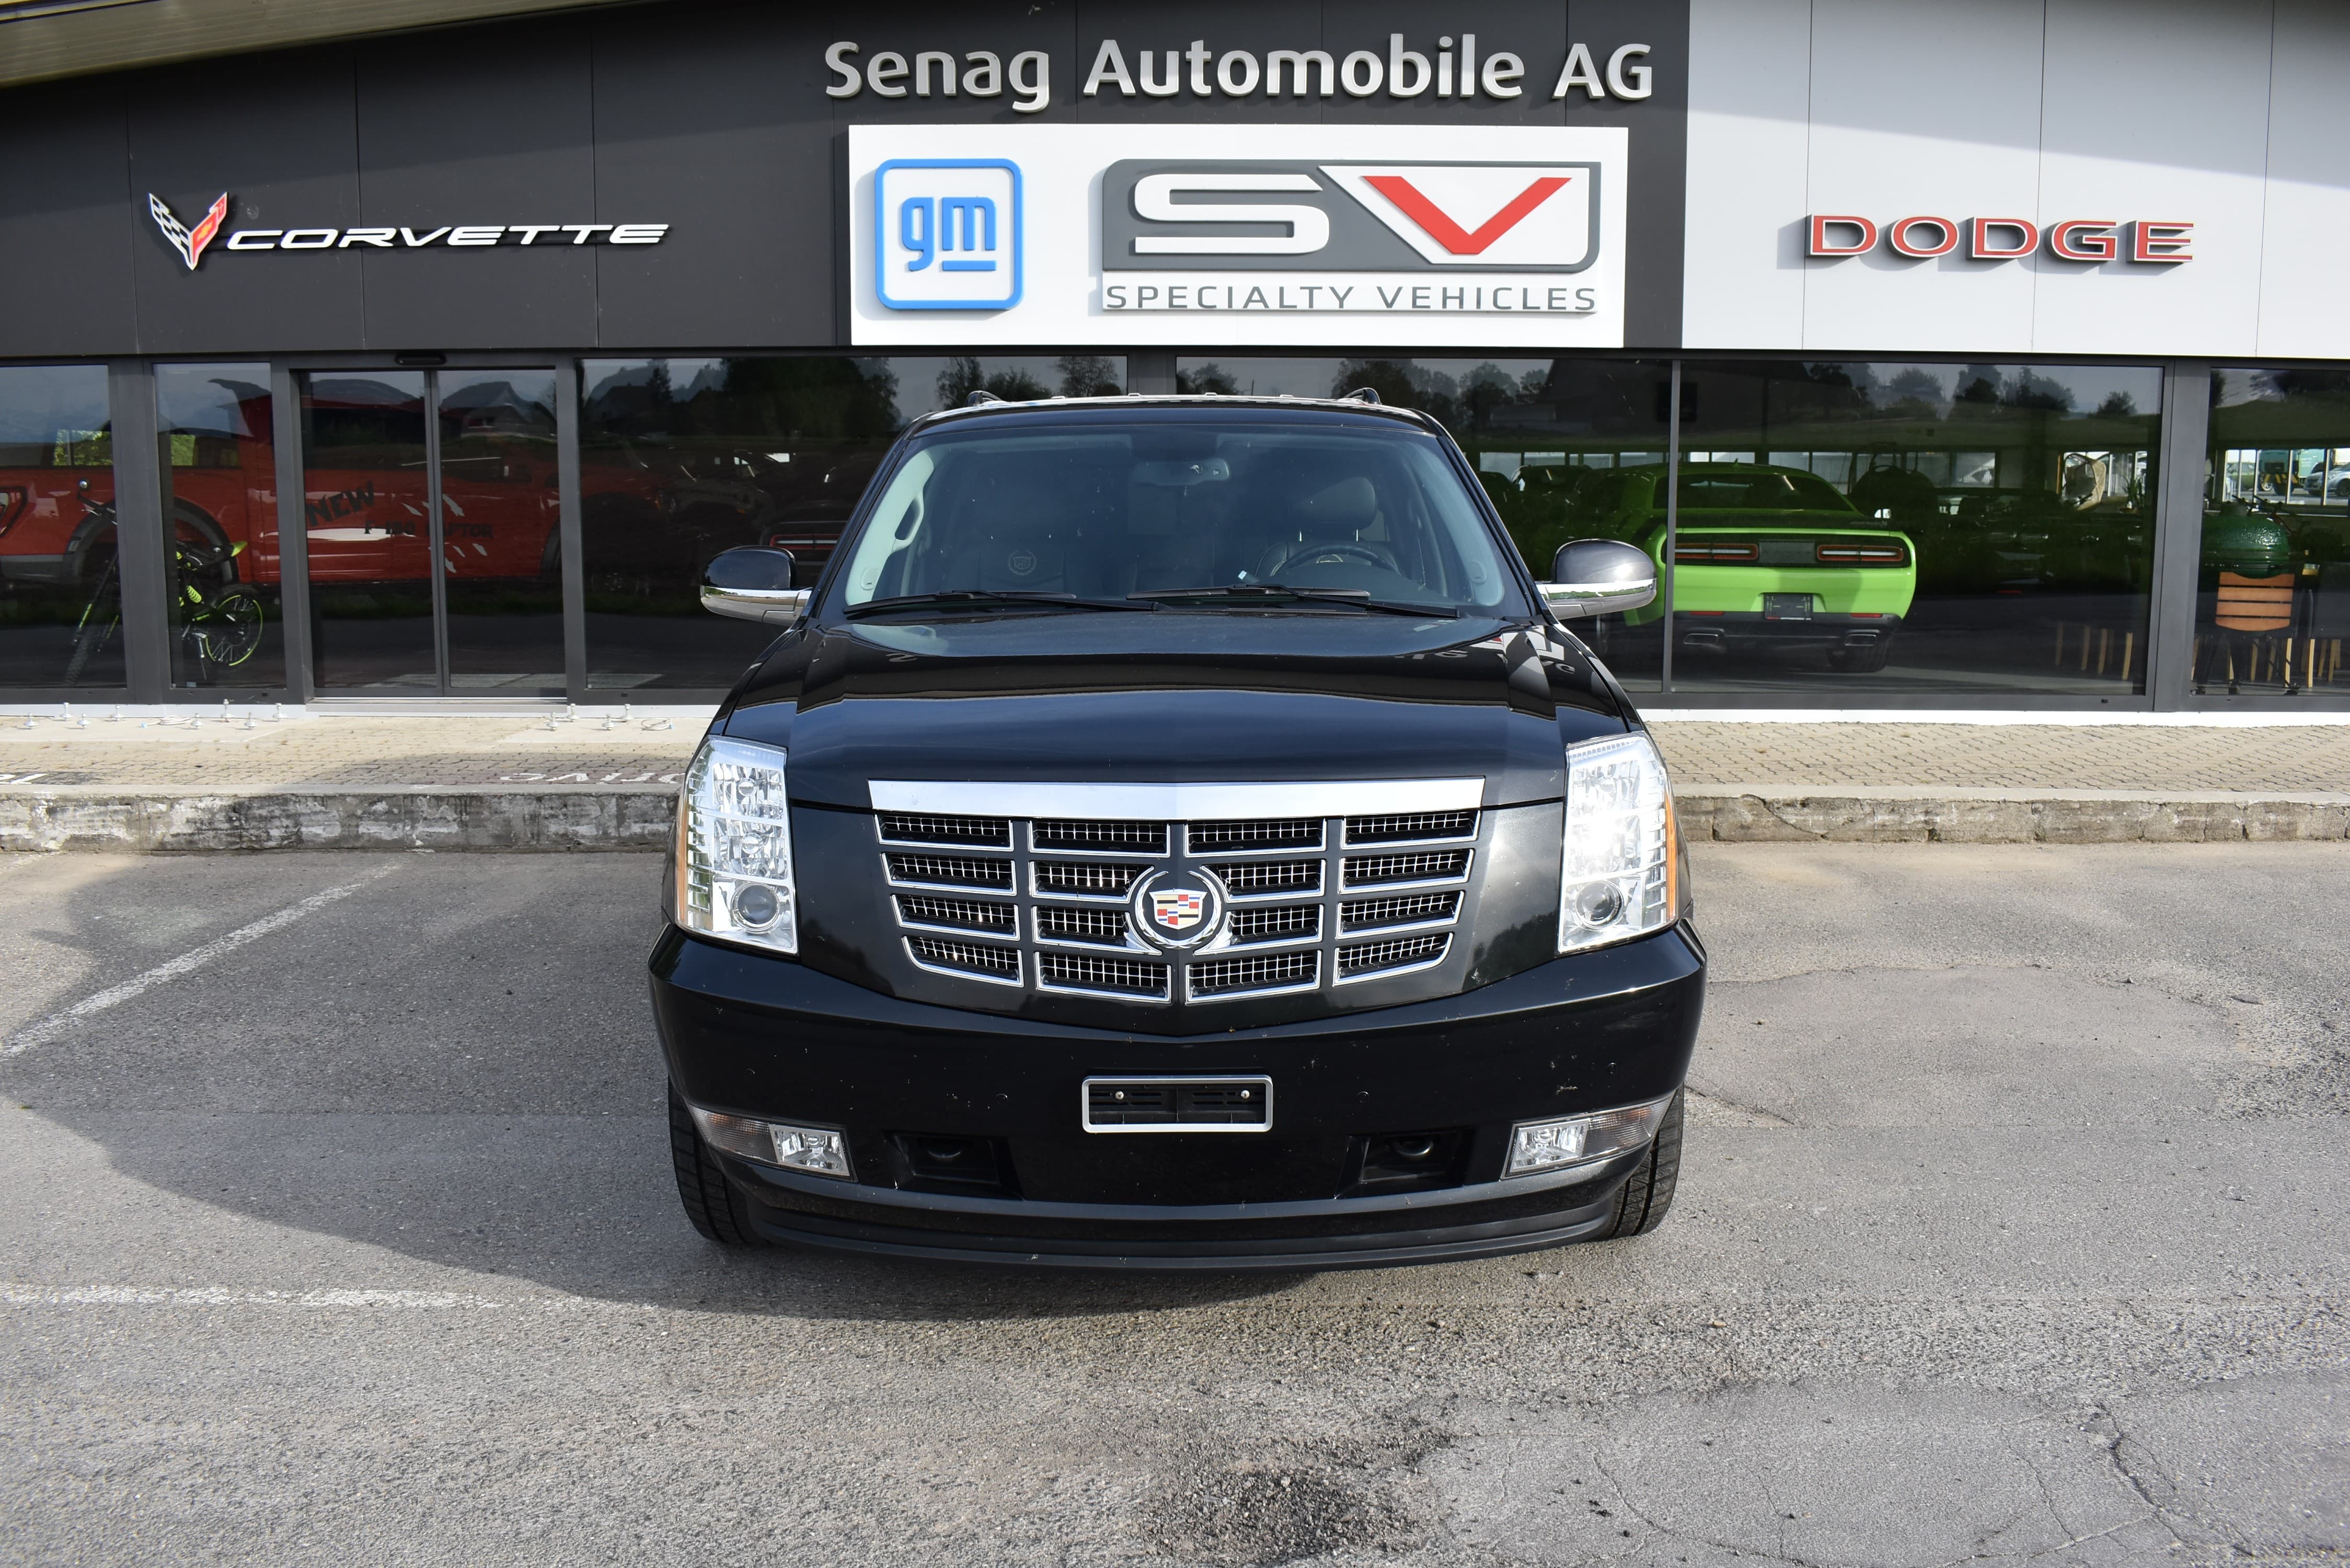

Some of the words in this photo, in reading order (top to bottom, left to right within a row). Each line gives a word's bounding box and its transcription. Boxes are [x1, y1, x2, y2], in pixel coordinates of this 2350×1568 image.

[825, 41, 1049, 112] Senag
[1083, 33, 1525, 98] Automobile
[1551, 43, 1652, 100] AG
[227, 224, 669, 250] CORVETTE
[901, 196, 997, 272] gm
[1805, 214, 2194, 262] DODGE
[1105, 285, 1354, 309] SPECIALTY
[1376, 286, 1595, 310] VEHICLES
[305, 480, 374, 526] NEW
